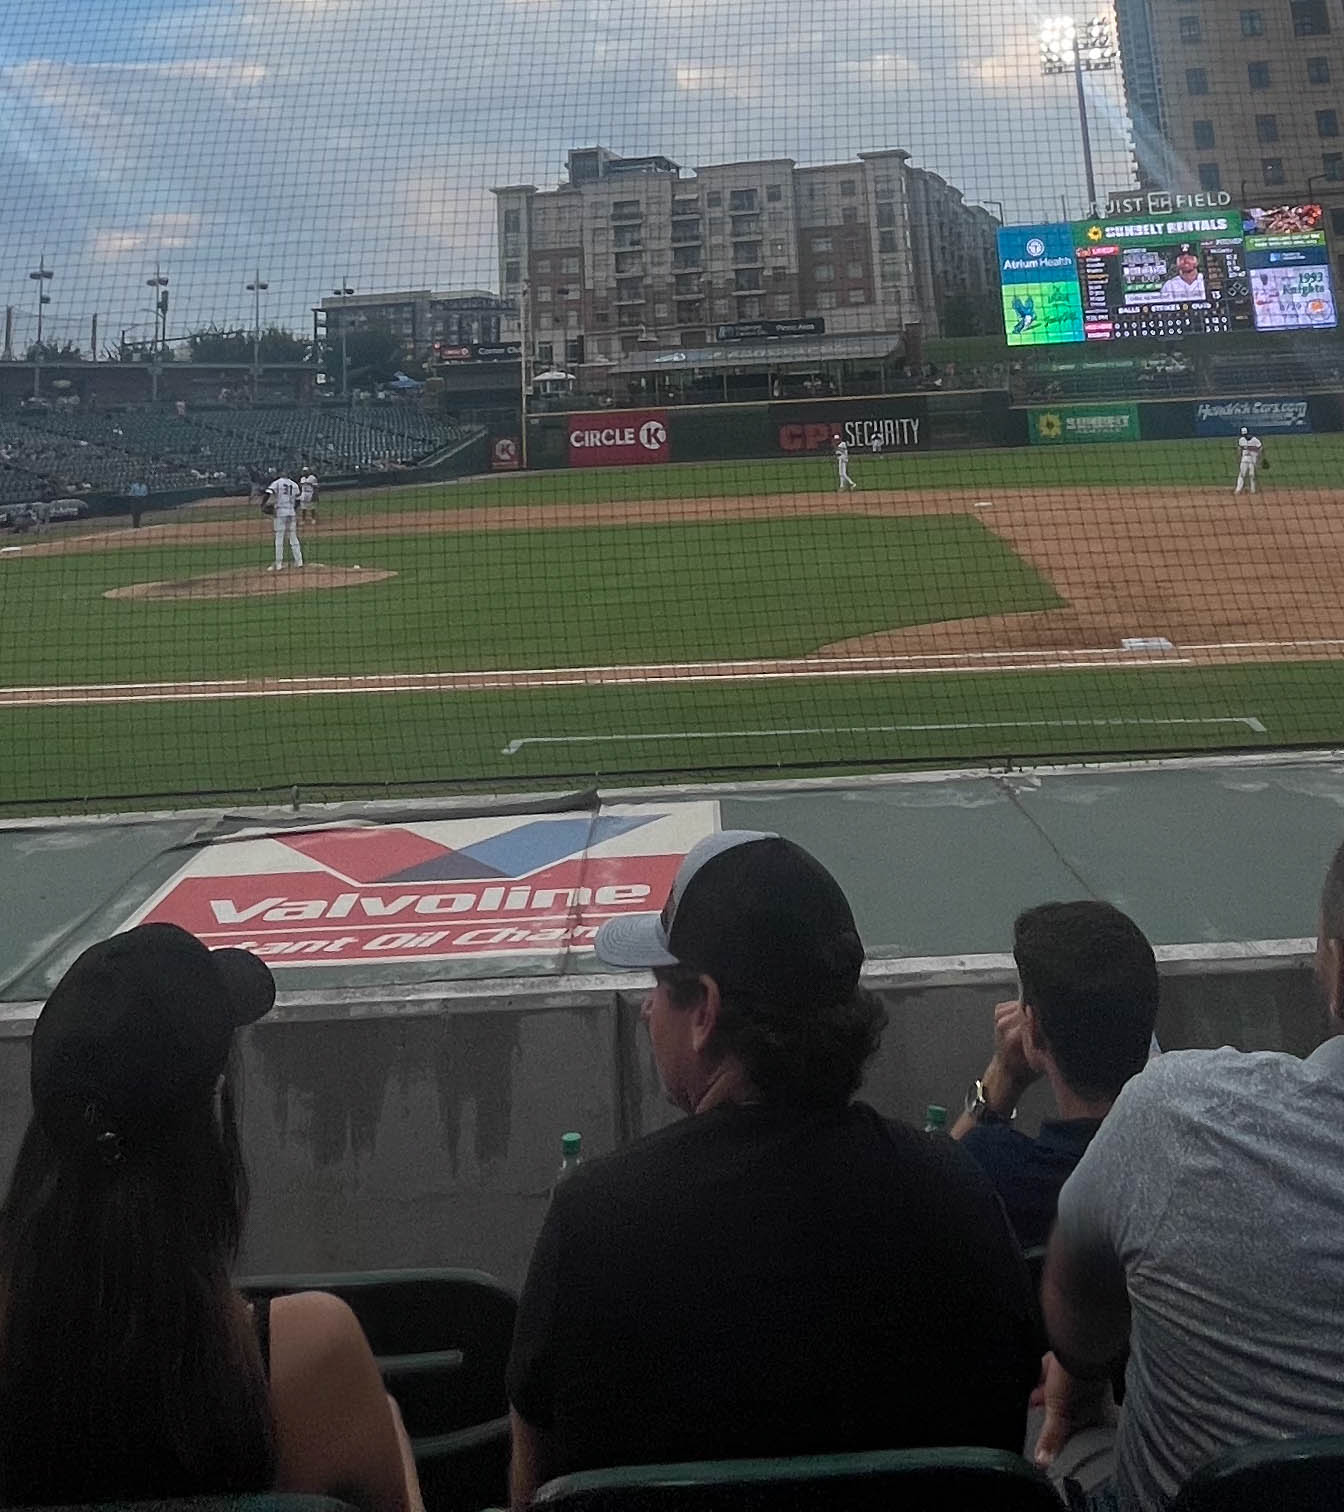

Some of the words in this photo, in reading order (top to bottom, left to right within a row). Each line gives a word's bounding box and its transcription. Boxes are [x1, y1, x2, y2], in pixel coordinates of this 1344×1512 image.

[1175, 191, 1232, 208] FIELD
[1105, 223, 1164, 238] SUNBELT
[1166, 218, 1228, 234] RENTALS
[1003, 258, 1038, 270] Atrium
[1039, 256, 1072, 267] Health
[1299, 272, 1323, 283] 1993
[1118, 306, 1140, 314] BALLS
[1151, 304, 1180, 313] STRIKES
[569, 427, 636, 448] CIRCLE
[639, 420, 667, 450] K
[845, 418, 920, 447] SECURITY
[495, 439, 516, 460] K
[282, 483, 293, 496] 31
[208, 880, 652, 925] Valvoline
[362, 930, 451, 950] Oil
[452, 924, 599, 946] Chan
